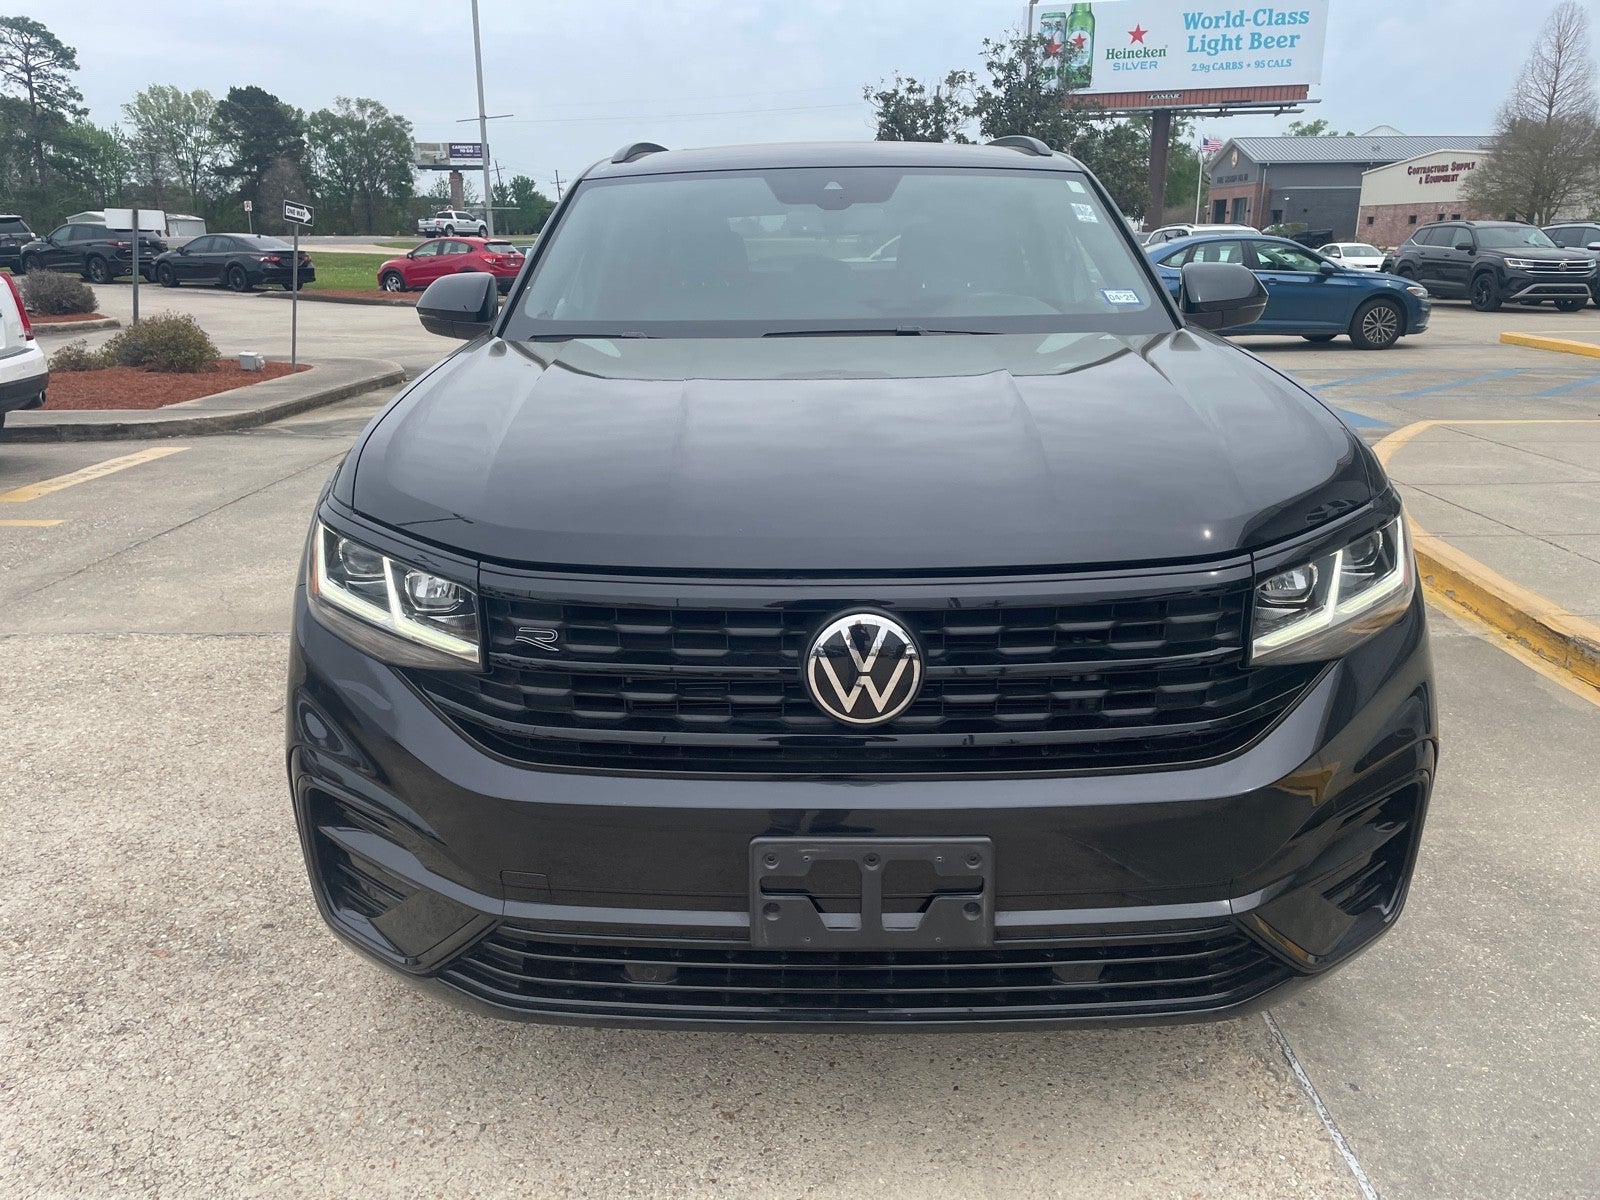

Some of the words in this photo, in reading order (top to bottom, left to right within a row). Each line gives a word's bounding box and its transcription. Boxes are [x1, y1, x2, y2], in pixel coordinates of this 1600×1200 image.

[1183, 8, 1310, 31] World-Class
[1187, 34, 1243, 57] Light
[1248, 32, 1301, 50] Beer
[1105, 46, 1167, 60] Heineken
[1112, 60, 1159, 71] SILVER
[1191, 62, 1210, 73] 2.9g
[1212, 61, 1244, 71] CARBS
[1254, 59, 1266, 69] 95
[1267, 58, 1293, 68] CALS
[286, 207, 296, 216] ONE
